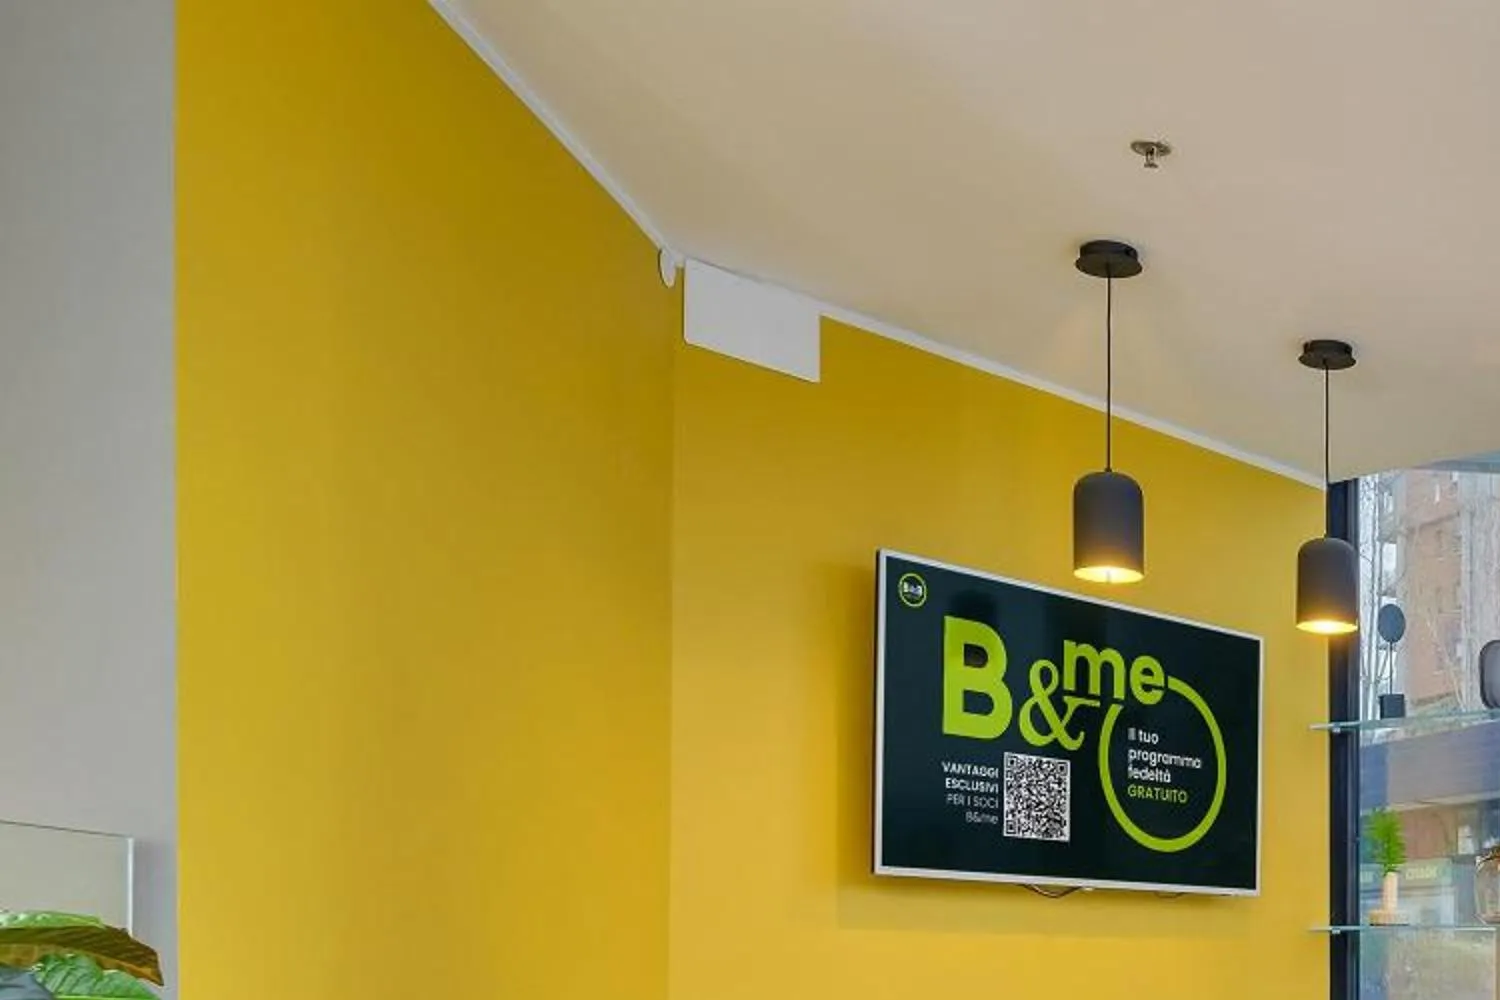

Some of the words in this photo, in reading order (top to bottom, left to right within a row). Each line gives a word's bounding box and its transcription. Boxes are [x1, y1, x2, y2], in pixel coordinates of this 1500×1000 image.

[1138, 729, 1159, 745] tuo
[1127, 748, 1202, 769] programma
[941, 761, 999, 779] VANTAGGI
[1127, 764, 1172, 783] fedeltà
[945, 777, 999, 794] ESCLUSIVI
[1127, 783, 1188, 804] GRATUITO
[973, 795, 999, 809] SOCI
